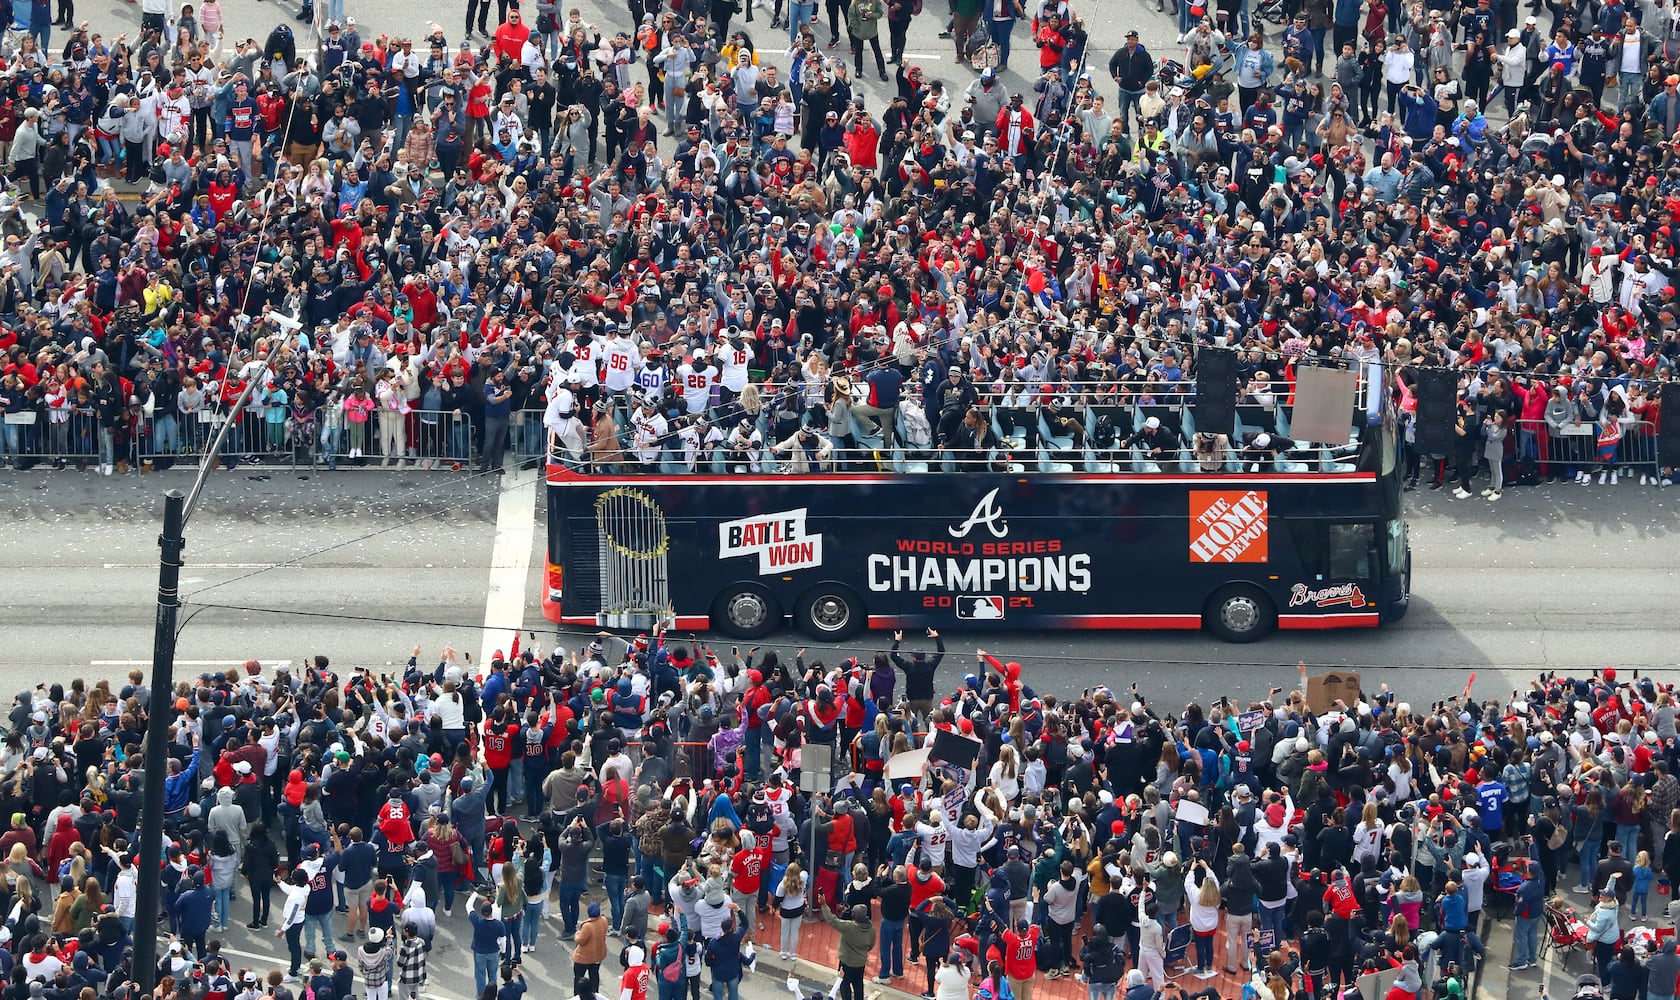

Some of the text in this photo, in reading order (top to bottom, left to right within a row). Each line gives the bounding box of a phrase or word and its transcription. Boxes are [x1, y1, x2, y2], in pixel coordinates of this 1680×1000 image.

[573, 346, 590, 361] 33
[733, 351, 747, 366] 16
[611, 353, 628, 371] 96
[642, 373, 660, 388] 60
[687, 375, 707, 389] 26
[1196, 497, 1231, 528] THE
[729, 519, 796, 548] BATTLE
[1189, 490, 1268, 563] HOME
[896, 539, 1062, 555] WORLD SERIES
[1220, 516, 1268, 563] DEPOT
[768, 541, 814, 567] WON
[867, 553, 1092, 592] CHAMPIONS
[922, 596, 952, 607] 20
[1008, 595, 1035, 608] 21
[1289, 582, 1353, 608] Braves
[375, 722, 383, 733] 5
[488, 736, 505, 751] 13
[526, 744, 544, 757] 10
[1480, 789, 1502, 799] MURPHY
[1487, 797, 1498, 811] 3
[389, 808, 404, 819] 25
[949, 808, 957, 822] 3
[931, 833, 946, 846] 22
[1369, 830, 1377, 845] 7
[747, 861, 761, 877] 13
[309, 874, 327, 892] 13
[1337, 886, 1351, 901] 13
[688, 955, 696, 966] 5
[1016, 946, 1032, 961] 10
